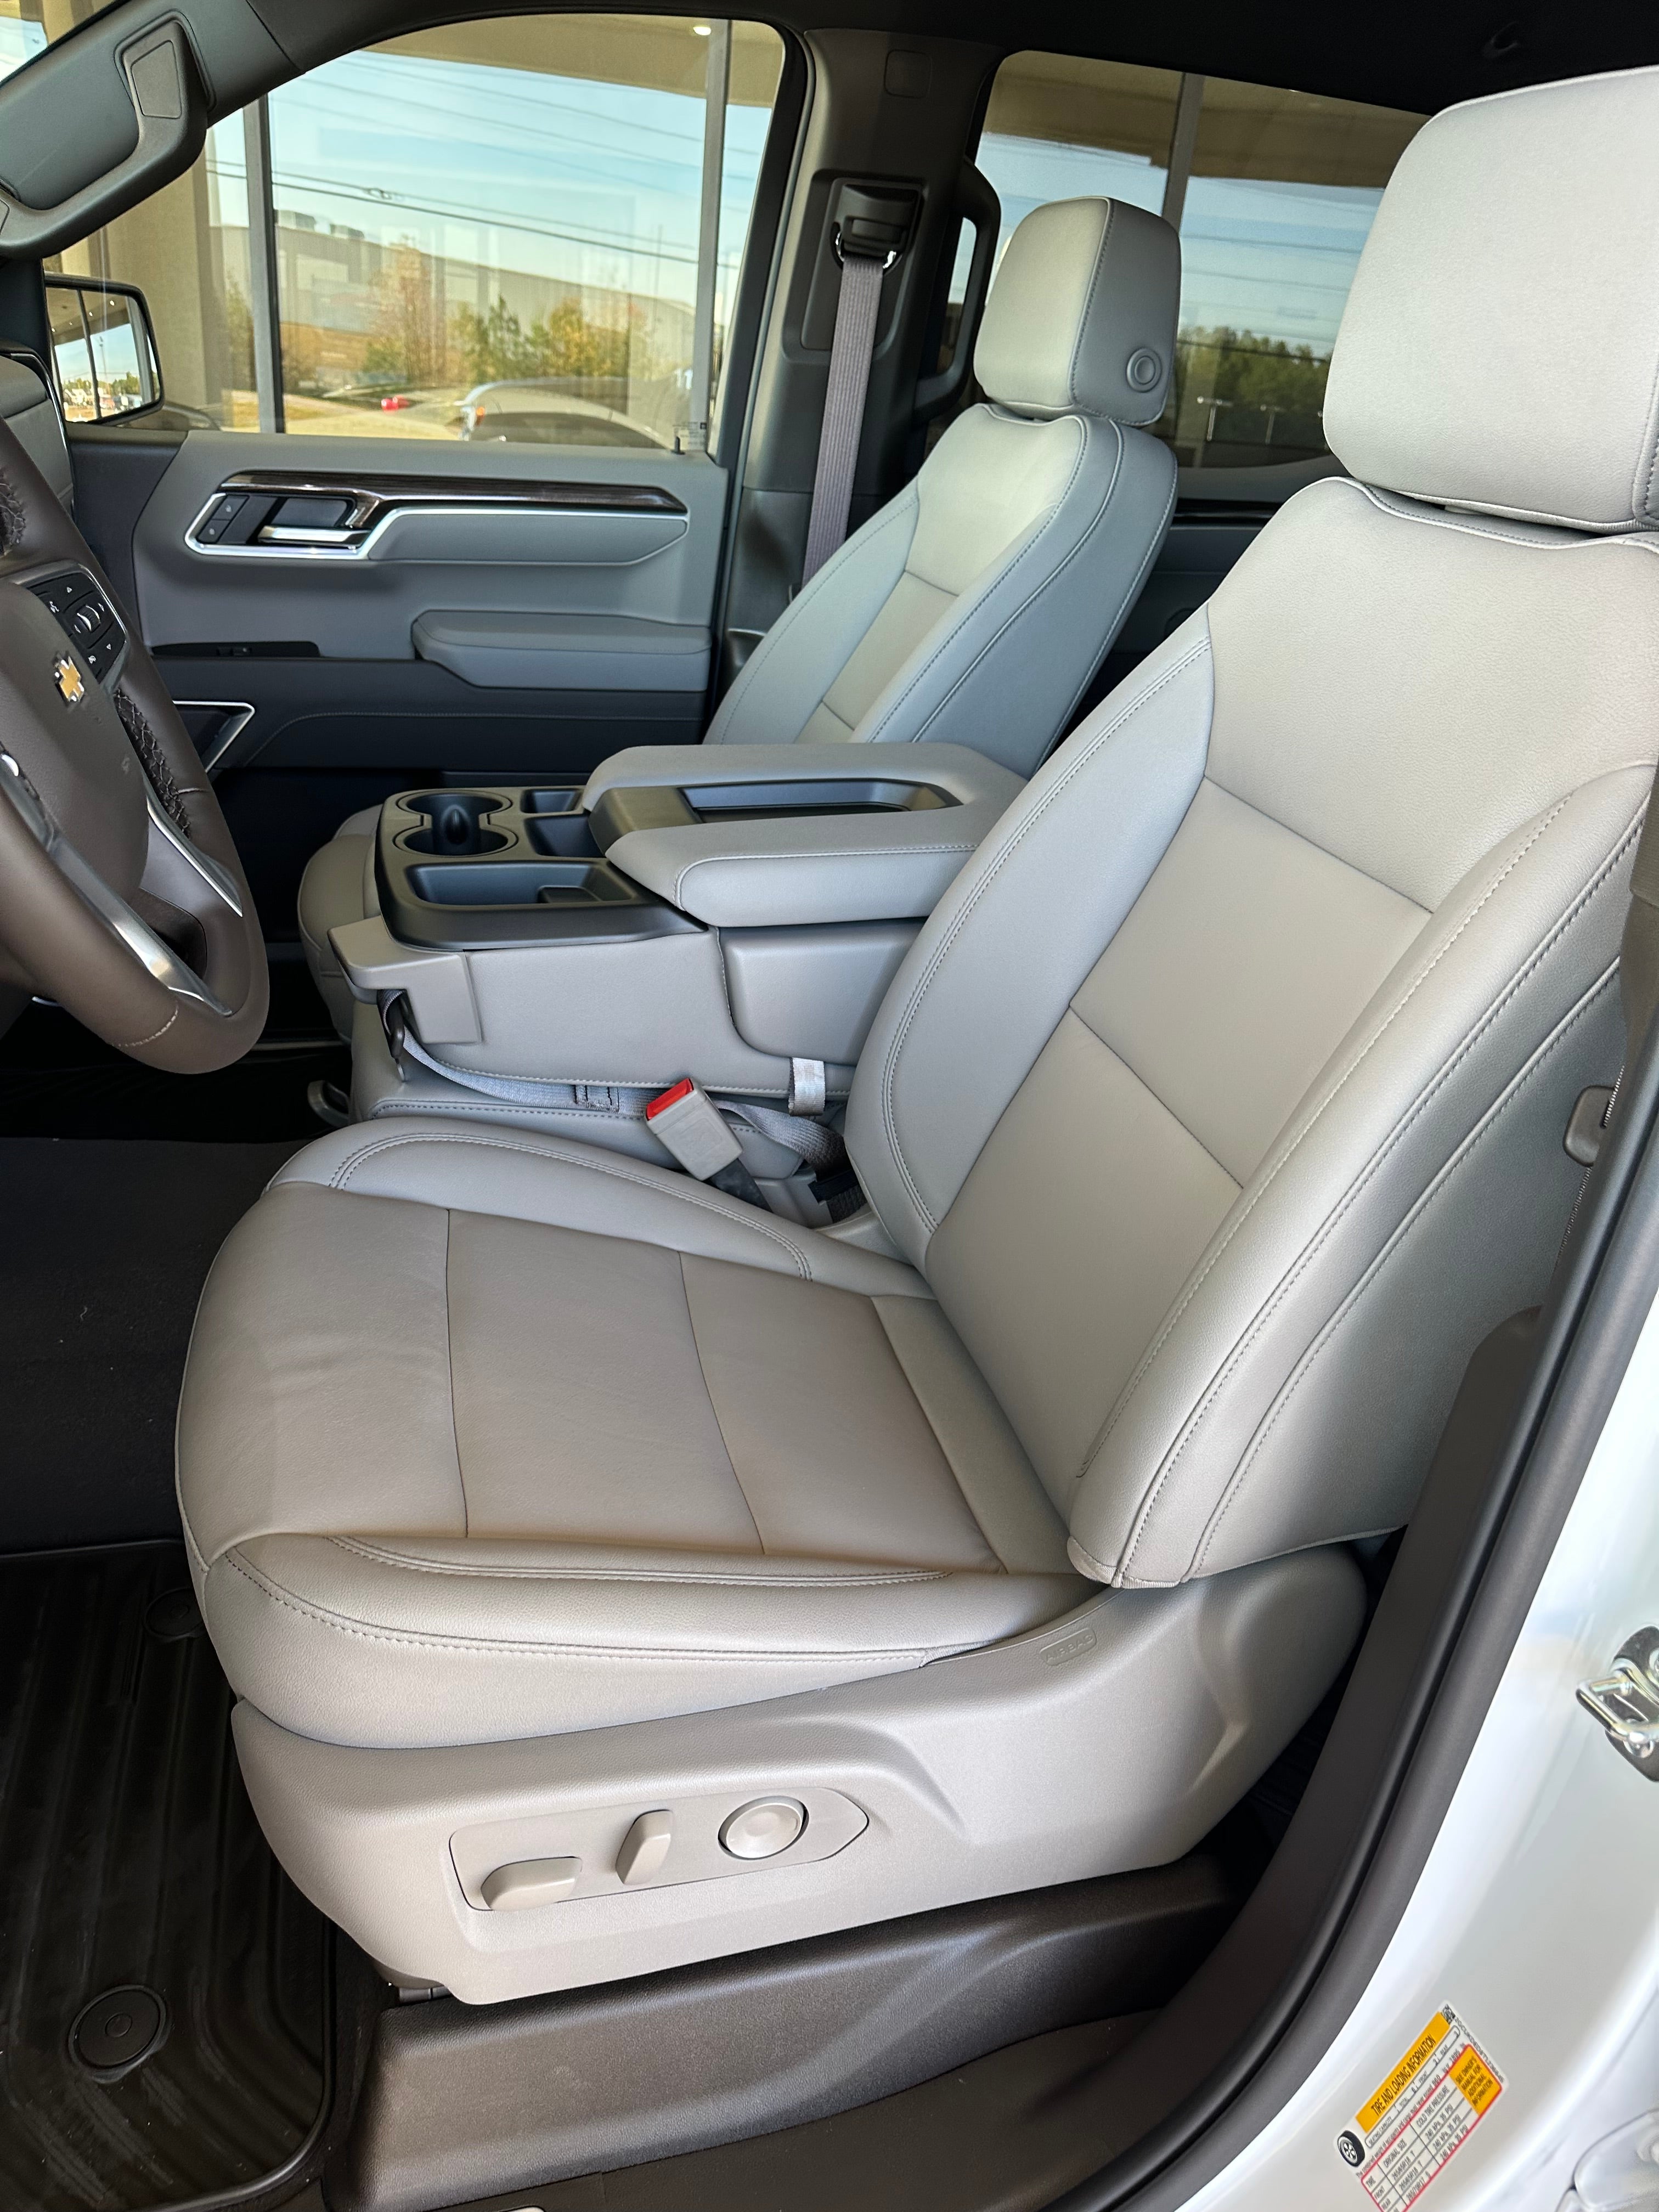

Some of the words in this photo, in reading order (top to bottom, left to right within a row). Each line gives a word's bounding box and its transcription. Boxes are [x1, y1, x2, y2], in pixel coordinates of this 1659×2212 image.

[1371, 2098, 1385, 2116] TIRE
[1380, 2087, 1393, 2105] AND
[1389, 2066, 1411, 2094] LOADING
[1406, 2034, 1436, 2073] INFORMATION
[1415, 2113, 1427, 2128] COLD
[1424, 2104, 1434, 2117] TIRE
[1431, 2084, 1449, 2108] PRESSURE
[1383, 2146, 1400, 2168] ORIGINAL
[1397, 2138, 1407, 2151] SIZE
[1365, 2176, 1375, 2188] TIRE
